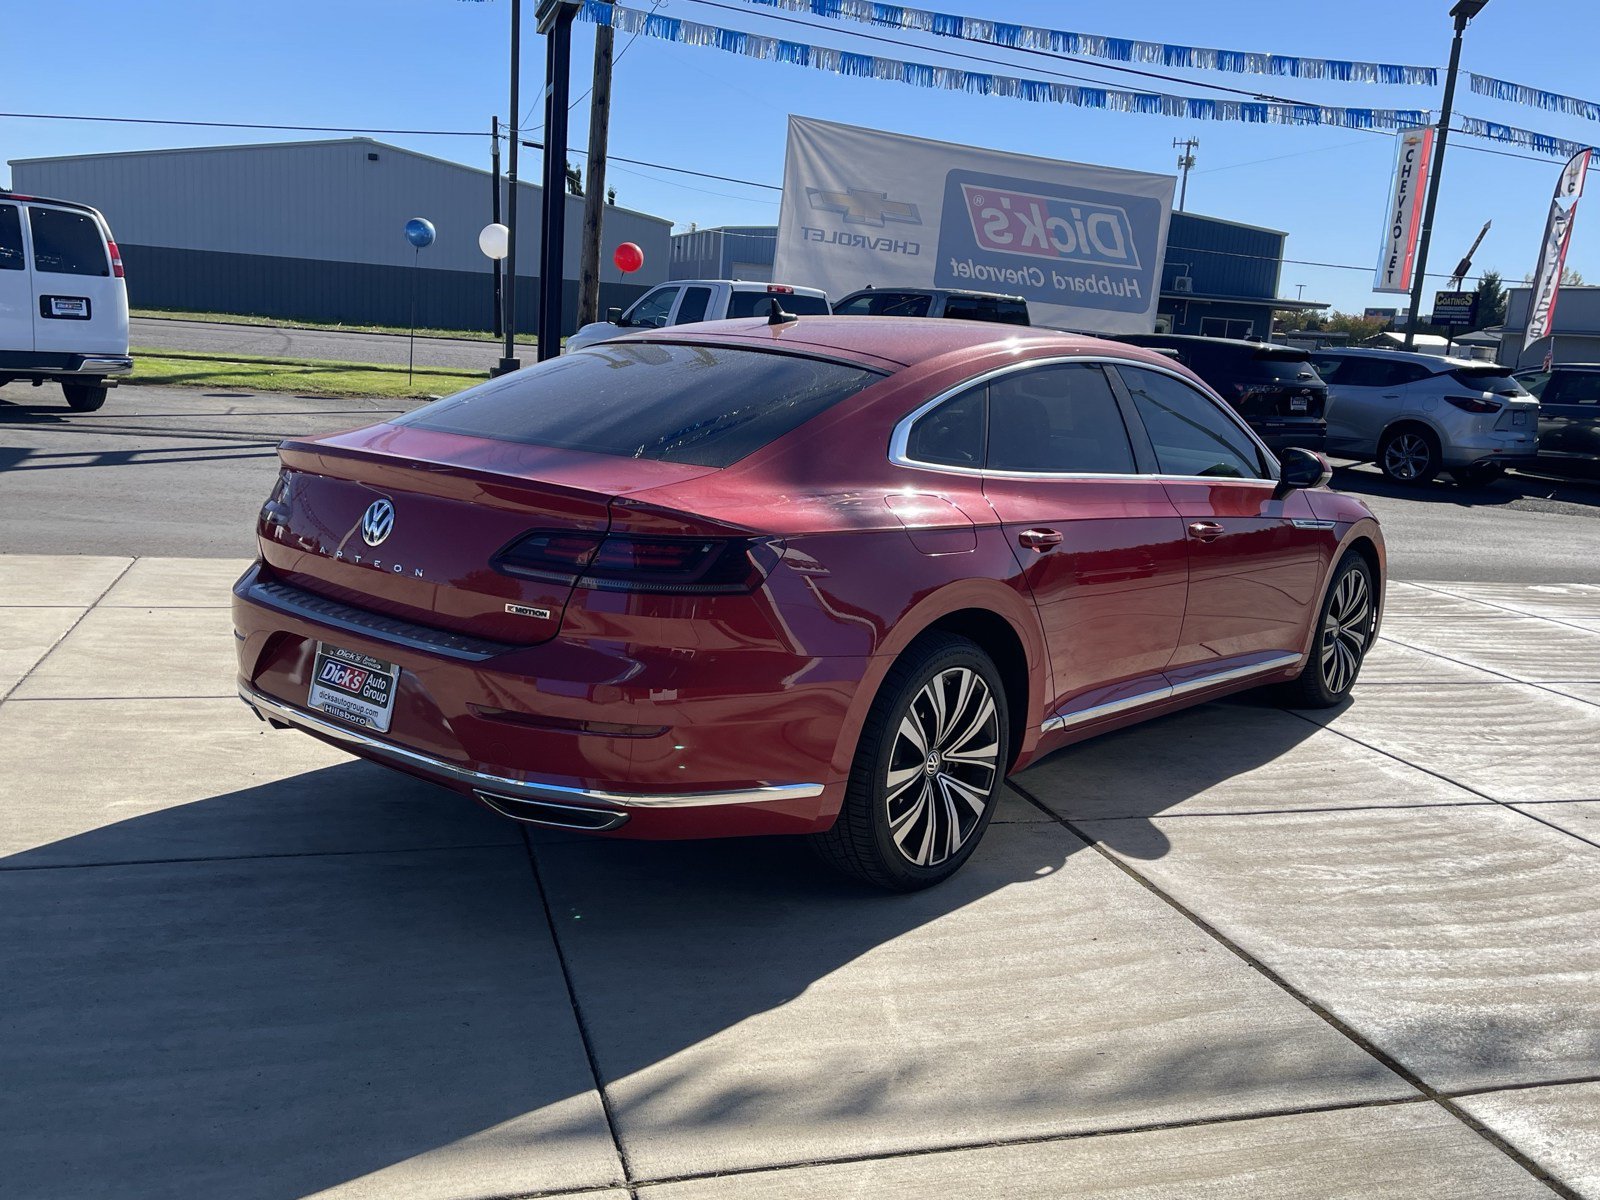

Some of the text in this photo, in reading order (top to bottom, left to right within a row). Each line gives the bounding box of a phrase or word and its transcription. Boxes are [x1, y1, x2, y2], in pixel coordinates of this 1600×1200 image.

[1387, 149, 1415, 284] CHEVROLET
[319, 546, 424, 577] ARTEON
[336, 649, 361, 662] Dick's
[320, 662, 387, 690] Dick's Auto
[318, 690, 379, 717] dicksautogroup.com
[362, 685, 387, 704] Group
[324, 704, 366, 725] Hillsboro
